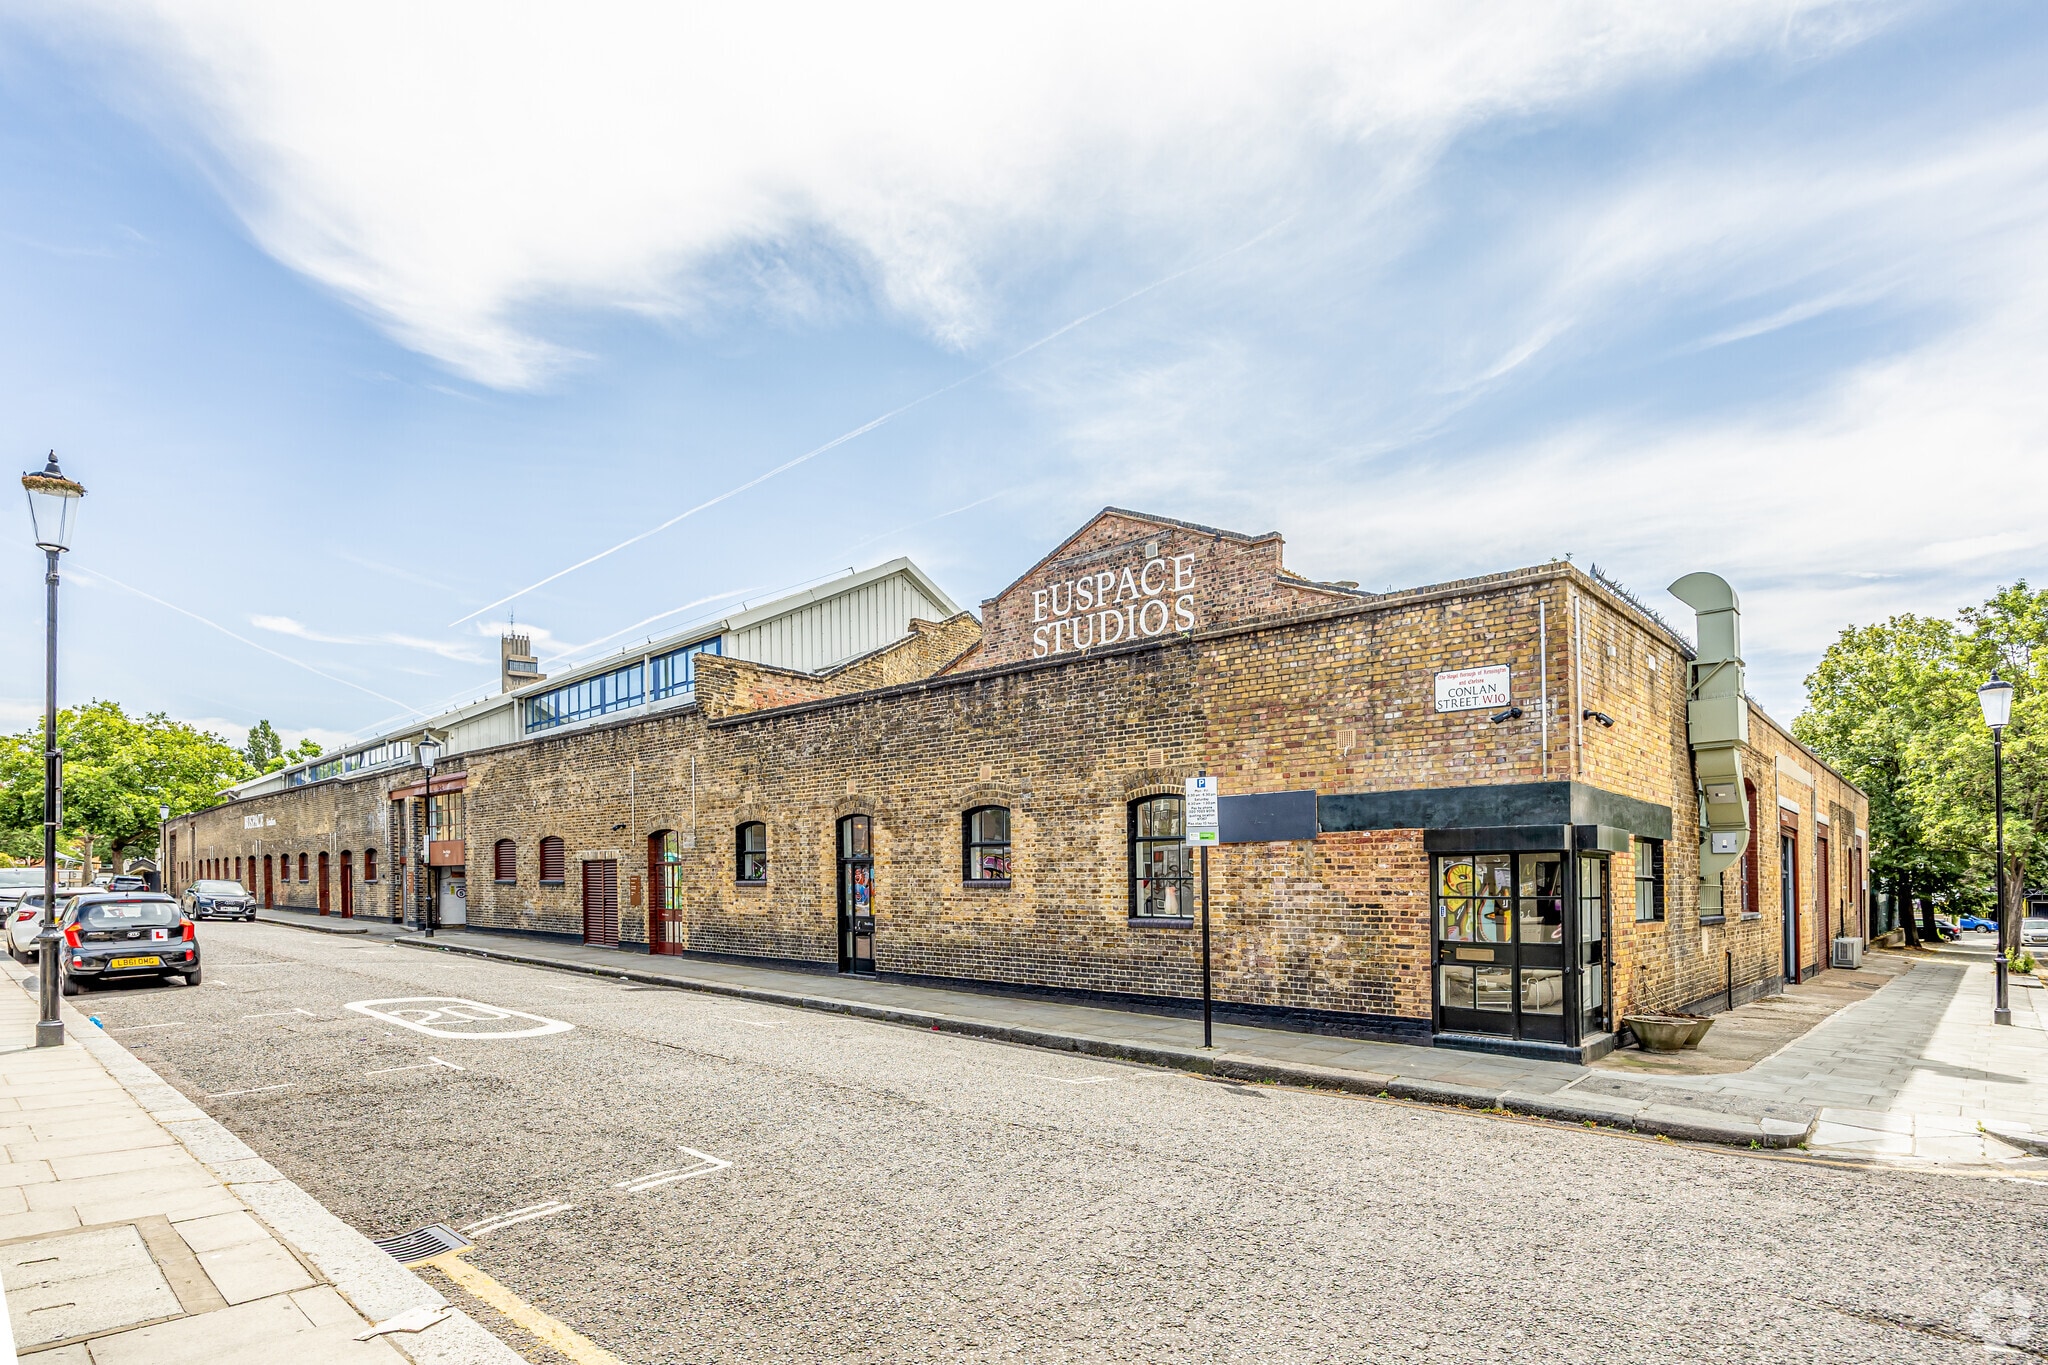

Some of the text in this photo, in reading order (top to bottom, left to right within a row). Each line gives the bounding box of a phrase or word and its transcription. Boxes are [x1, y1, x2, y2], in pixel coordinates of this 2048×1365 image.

[1032, 594, 1195, 659] STUDIOS
[1484, 667, 1506, 675] Kensington
[1448, 683, 1497, 698] CONLAN
[155, 931, 164, 939] L
[117, 959, 137, 967] LB61
[388, 1005, 512, 1026] 20
